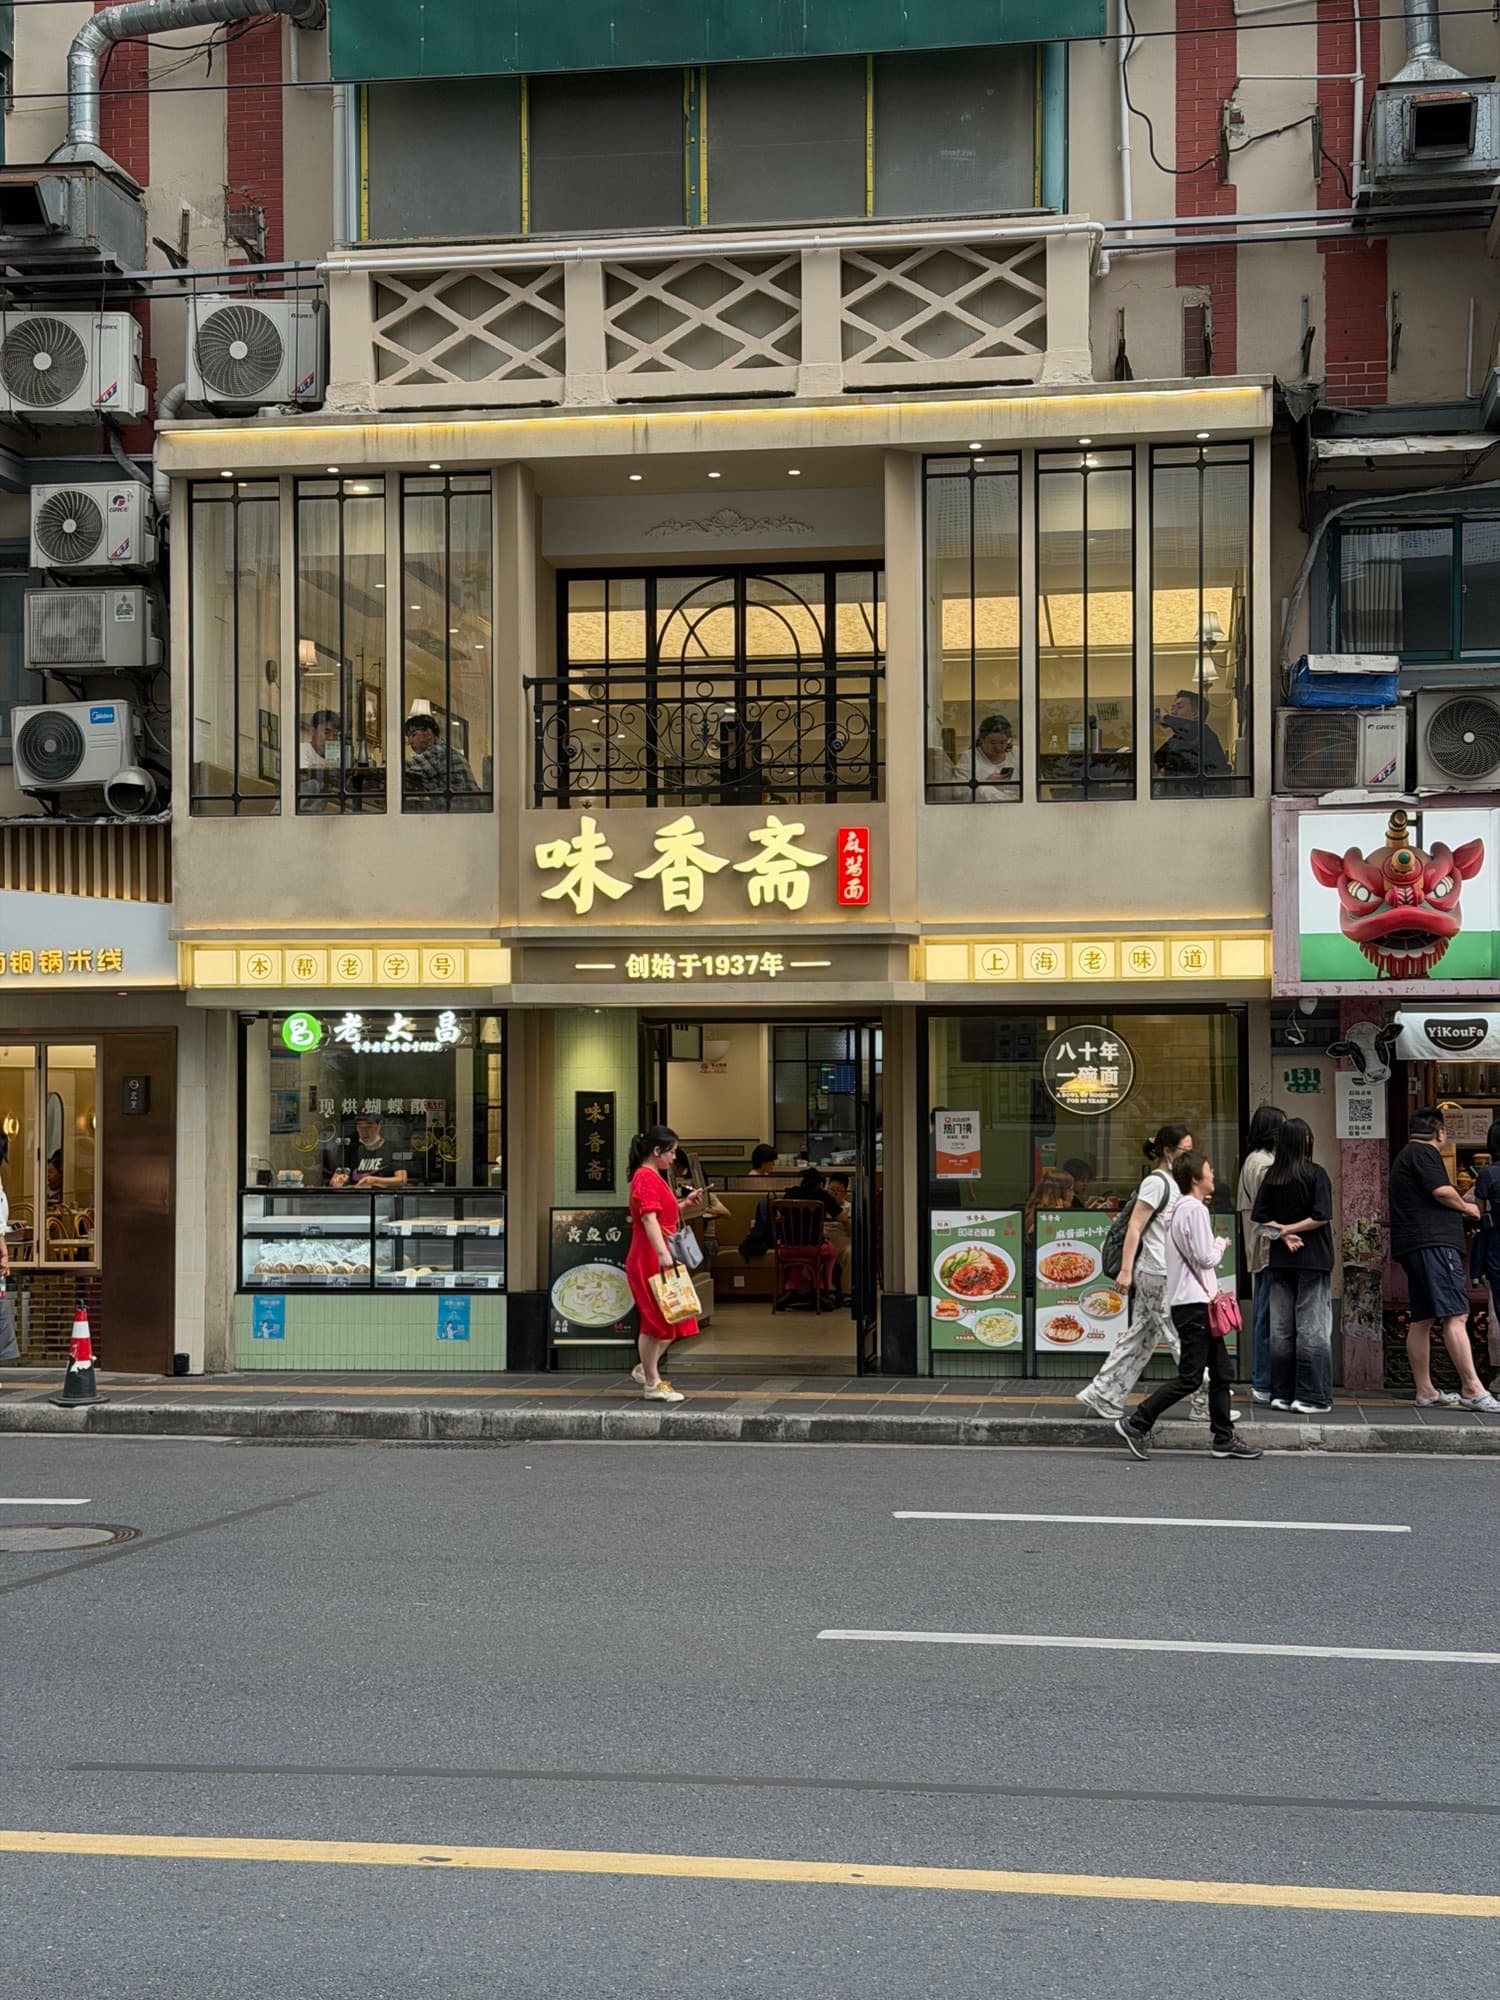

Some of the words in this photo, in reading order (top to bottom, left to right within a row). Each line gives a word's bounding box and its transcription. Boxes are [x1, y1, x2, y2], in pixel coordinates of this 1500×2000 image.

[534, 815, 829, 914] 味香斋
[0, 948, 123, 975] 铜锅米线
[250, 956, 453, 977] 本帮老字号
[626, 952, 785, 979] 创始于1937年
[986, 949, 1204, 972] 上海老味道
[333, 1011, 462, 1044] 老大昌
[1426, 1026, 1485, 1038] YiKouFa
[1056, 1041, 1119, 1061] 八十年
[1056, 1065, 1119, 1086] 一碗面
[1287, 1068, 1317, 1084] 151
[319, 1098, 428, 1116] 现烘蝴蝶酥
[584, 1102, 607, 1181] 味香斋
[357, 1158, 384, 1171] NIKE
[566, 1225, 622, 1243] 黄鱼面
